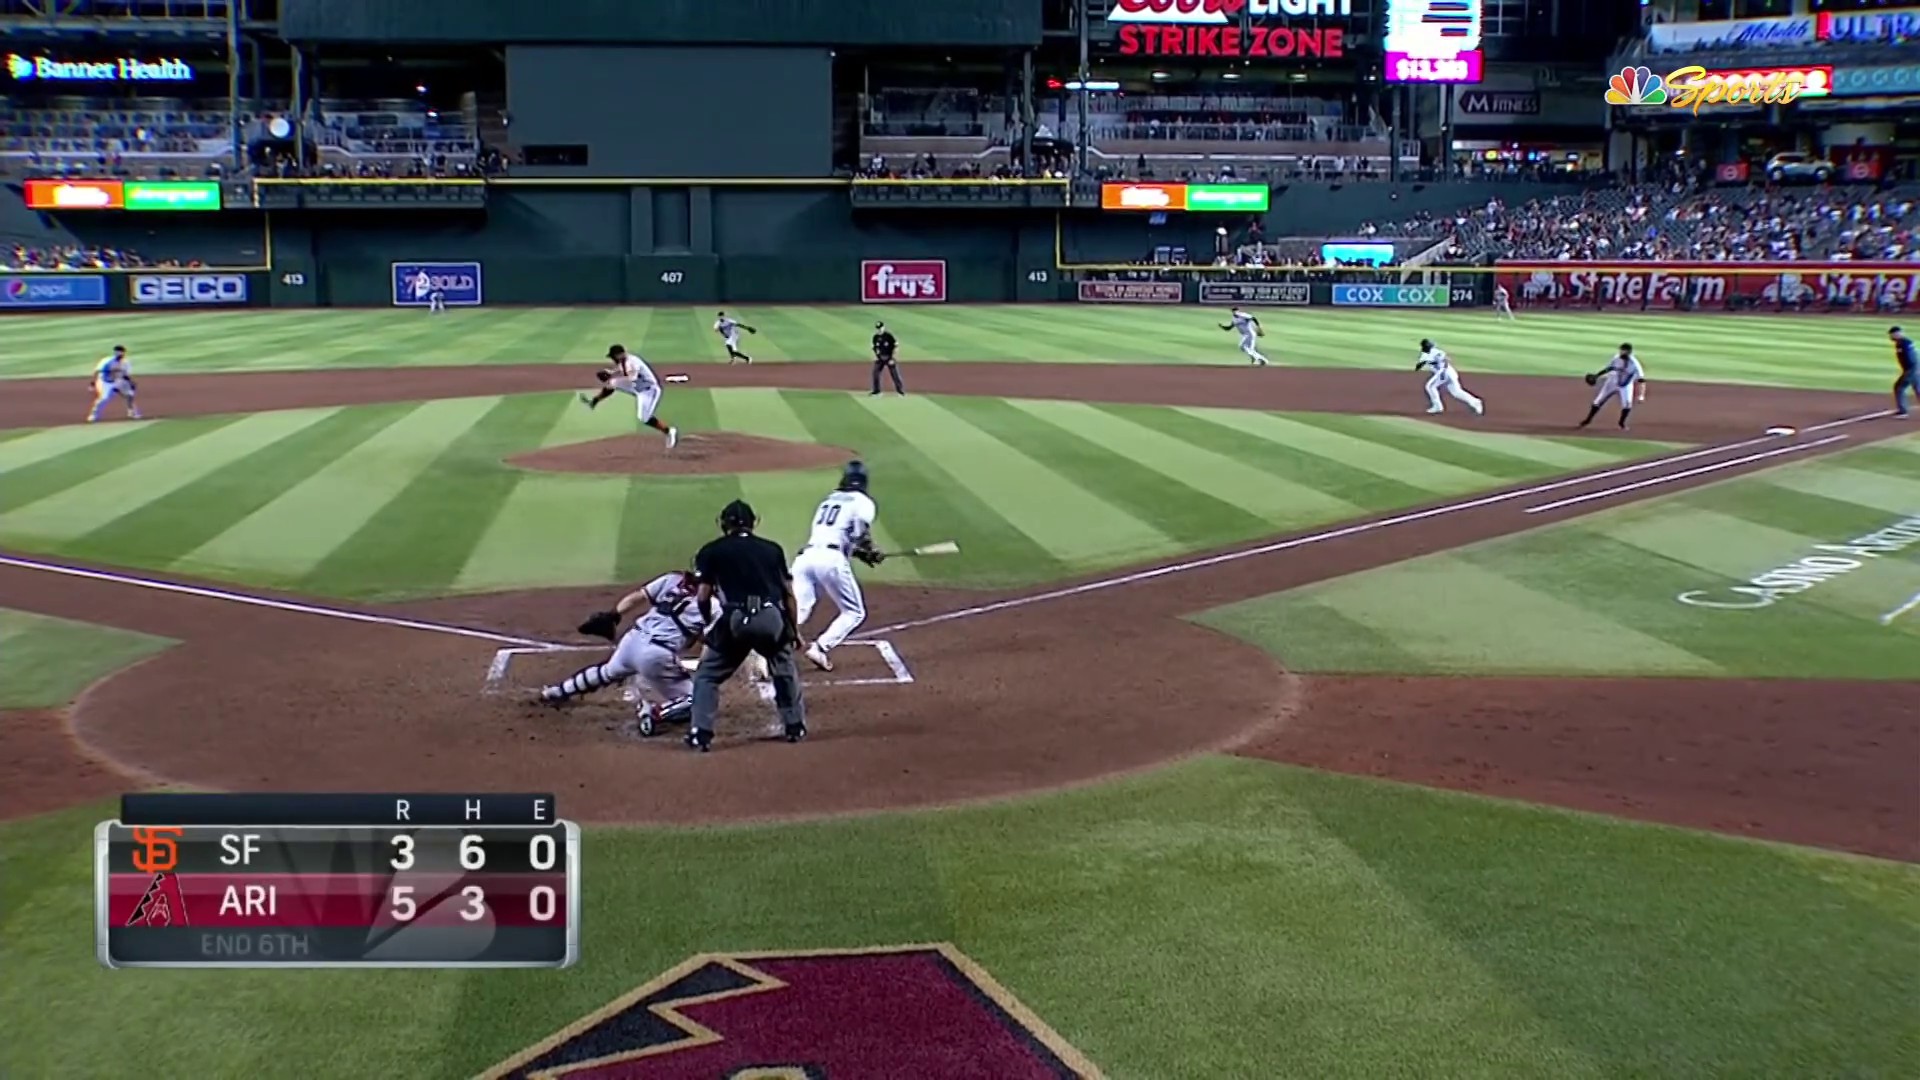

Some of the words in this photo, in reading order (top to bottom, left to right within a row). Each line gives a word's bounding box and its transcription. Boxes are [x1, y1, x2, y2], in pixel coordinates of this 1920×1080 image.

[1119, 25, 1240, 55] STRIKE
[1248, 27, 1343, 57] ZONE
[34, 56, 116, 79] Banner
[117, 57, 192, 79] Health
[282, 273, 304, 285] 413
[661, 270, 683, 283] 407
[871, 264, 937, 297] fry's
[1028, 270, 1048, 283] 413
[134, 276, 243, 300] GEICO
[1346, 288, 1383, 301] COX
[1398, 288, 1435, 302] COX
[1452, 289, 1473, 301] 374
[1569, 272, 1643, 301] State
[1678, 556, 1862, 609] CASINO
